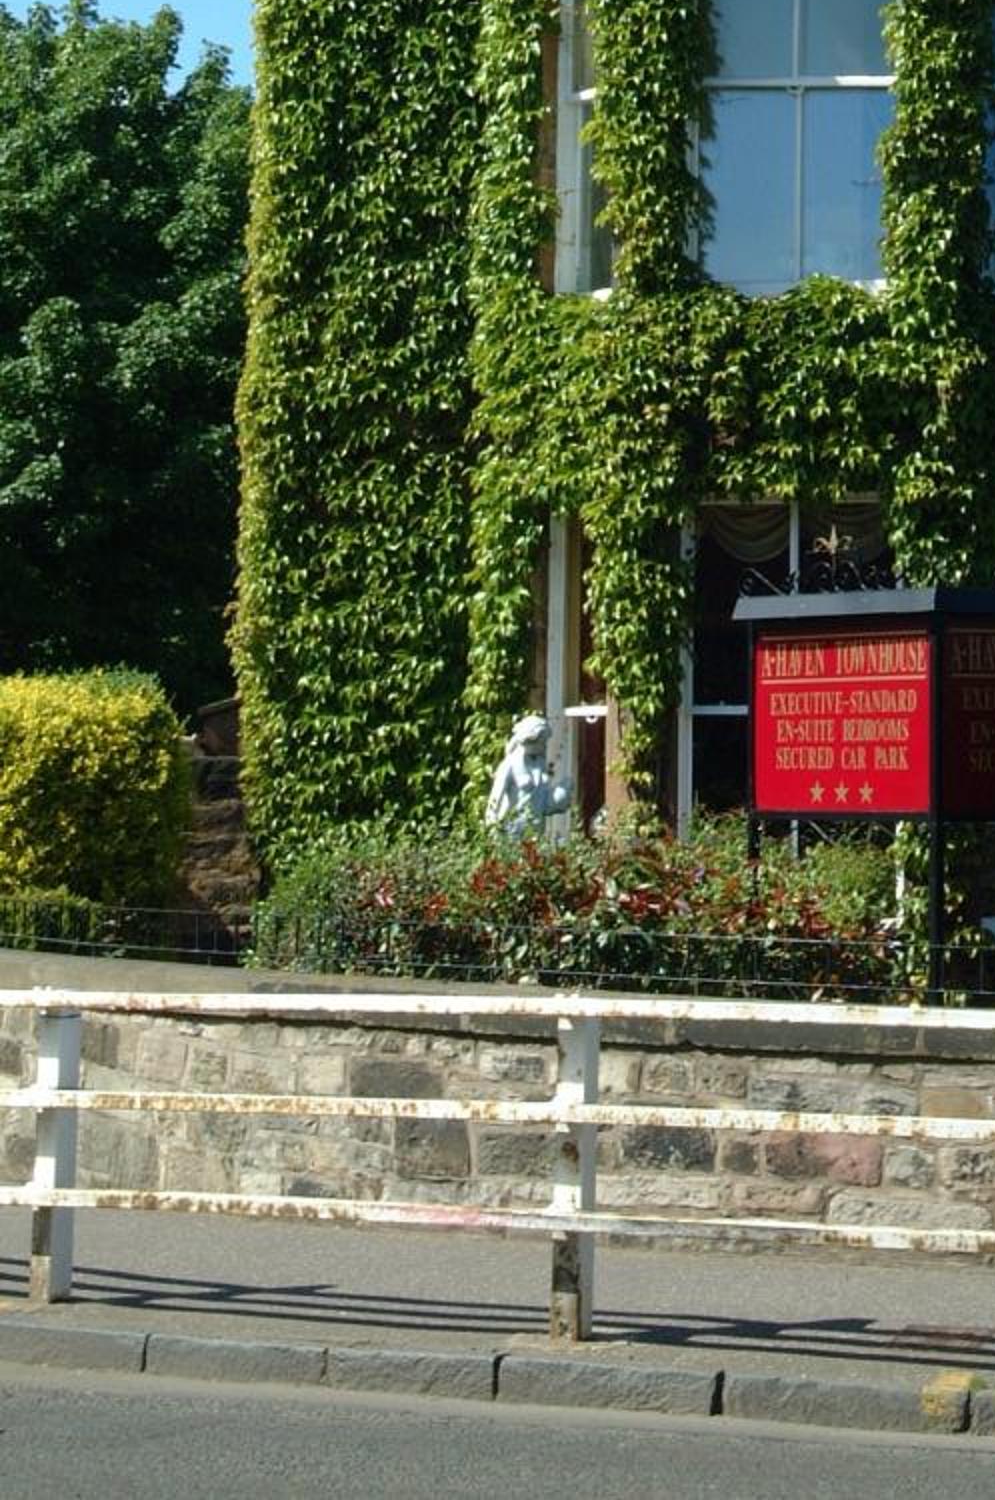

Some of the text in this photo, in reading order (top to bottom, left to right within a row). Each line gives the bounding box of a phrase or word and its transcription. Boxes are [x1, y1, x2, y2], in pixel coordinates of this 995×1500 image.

[836, 637, 927, 675] TOWNHOUSE
[770, 689, 918, 716] EXECUTIVE-STANDARD
[777, 718, 909, 742] EN-SUITE BEDROOMS
[776, 745, 909, 770] SECURED CAR PARK
